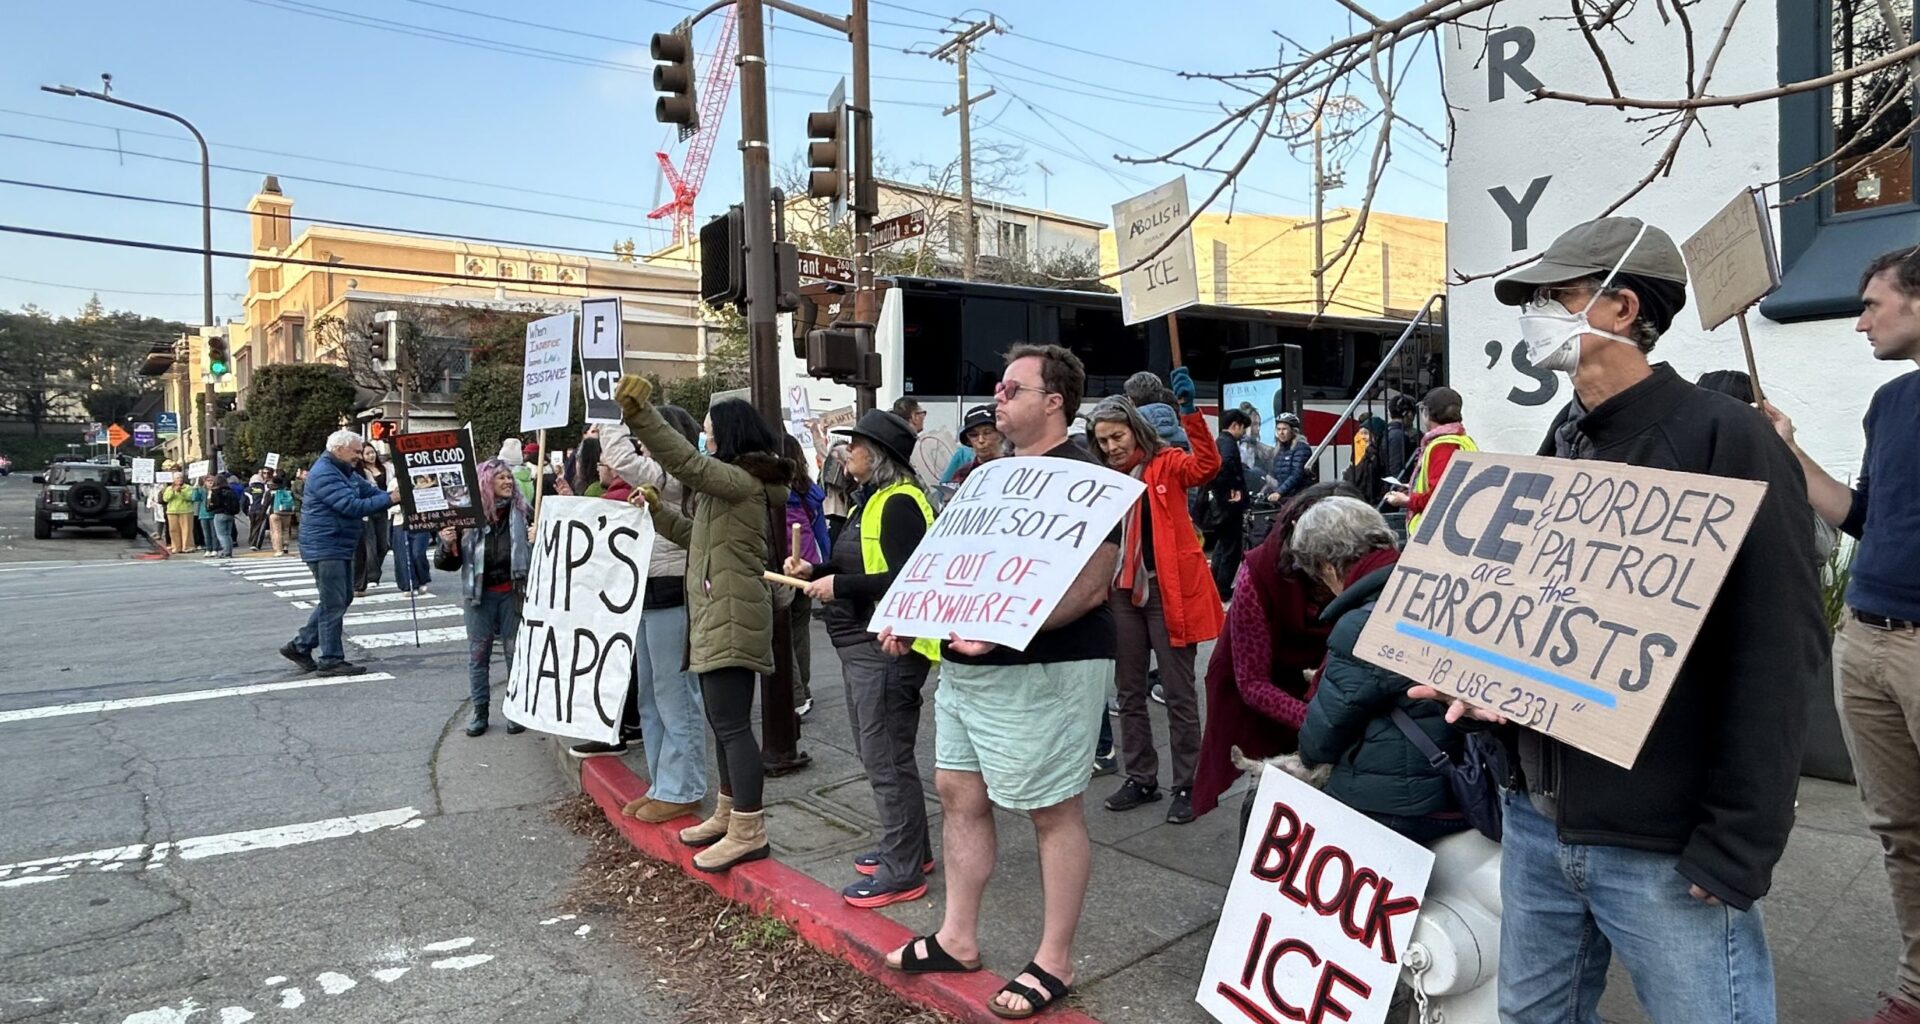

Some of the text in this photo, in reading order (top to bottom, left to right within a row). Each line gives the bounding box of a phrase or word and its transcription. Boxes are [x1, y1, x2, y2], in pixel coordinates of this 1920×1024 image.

[1129, 203, 1181, 240] ABOLISH
[1687, 198, 1754, 264] ABOLISH
[798, 258, 820, 276] rant
[824, 263, 837, 275] Ave
[1143, 256, 1179, 292] ICE
[1706, 249, 1738, 301] ICE
[529, 324, 547, 339] When
[592, 315, 605, 345] F
[526, 367, 568, 386] RESISTANCE
[586, 370, 621, 401] ICE
[404, 447, 465, 468] FOR GOOD
[954, 466, 1122, 508] ICE OUT OF
[931, 505, 1088, 549] MINNESOTA
[1413, 460, 1554, 565] ICE
[1554, 471, 1735, 551] BORDER
[525, 515, 640, 615] MP'S
[905, 551, 1050, 586] ICE OUT OF
[1471, 562, 1580, 606] are the
[1529, 529, 1701, 610] PATROL
[883, 589, 1043, 628] EVERYWHERE!
[1385, 565, 1678, 694] TERRORISTS
[1456, 670, 1501, 704] USC
[1250, 801, 1420, 964] BLOCK
[1240, 912, 1373, 1024] ICE
